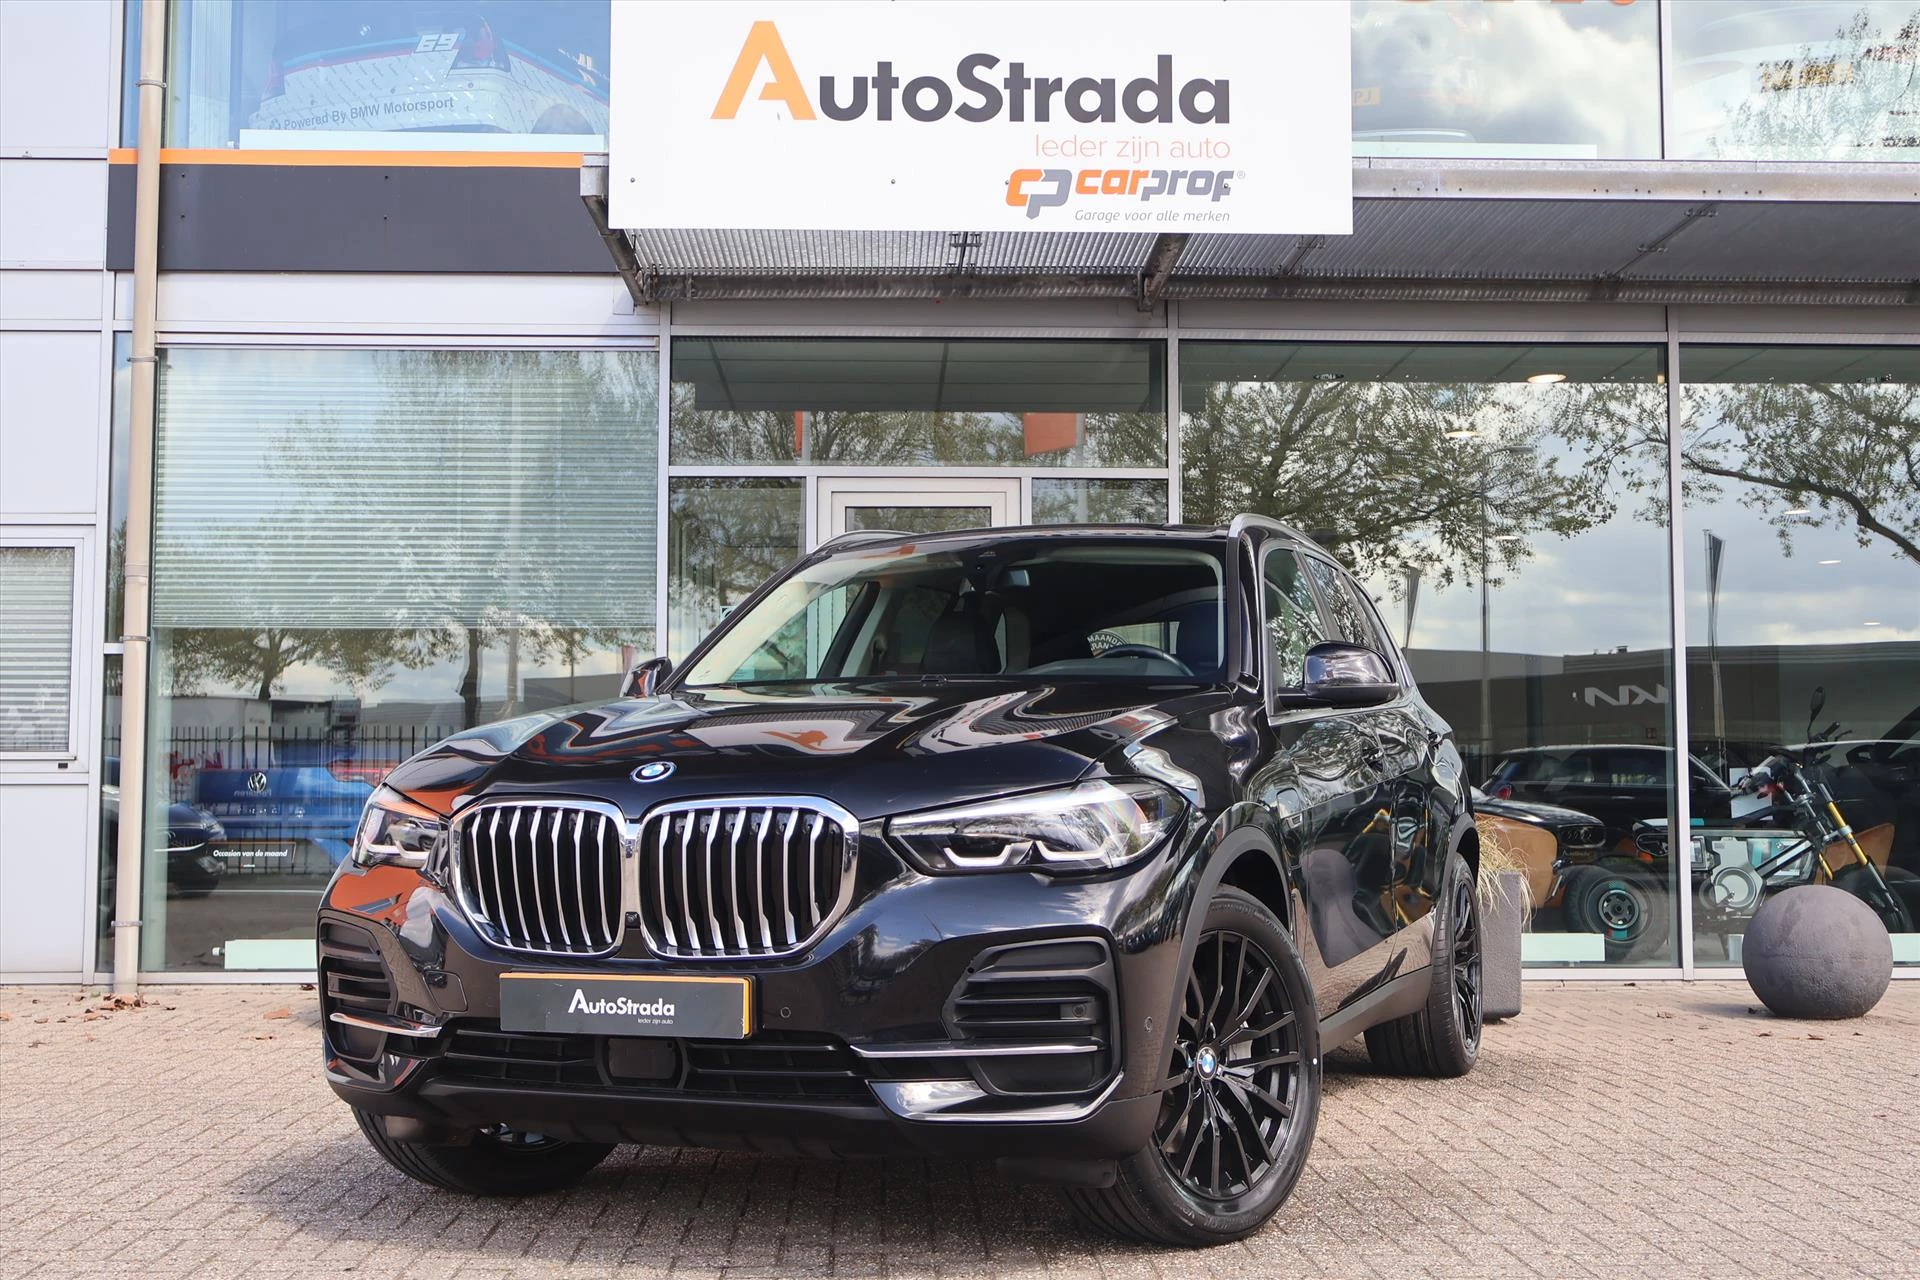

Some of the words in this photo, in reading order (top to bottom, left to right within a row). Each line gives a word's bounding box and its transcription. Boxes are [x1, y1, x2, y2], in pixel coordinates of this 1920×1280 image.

[415, 33, 459, 53] 69
[710, 20, 1230, 124] AutoStrada
[283, 112, 329, 130] Powered
[332, 110, 346, 124] By
[350, 104, 381, 120] BMW
[384, 96, 455, 115] Motorsport
[1035, 134, 1108, 158] Ieder
[1115, 136, 1160, 164] zijn
[1169, 136, 1231, 159] auto
[1074, 210, 1120, 224] Garage
[1124, 212, 1153, 222] voor
[1156, 210, 1180, 222] alle
[1183, 212, 1230, 222] merken
[213, 849, 241, 857] Occasion
[255, 849, 263, 857] de
[264, 849, 288, 857] maand
[567, 988, 675, 1017] AutoStrada
